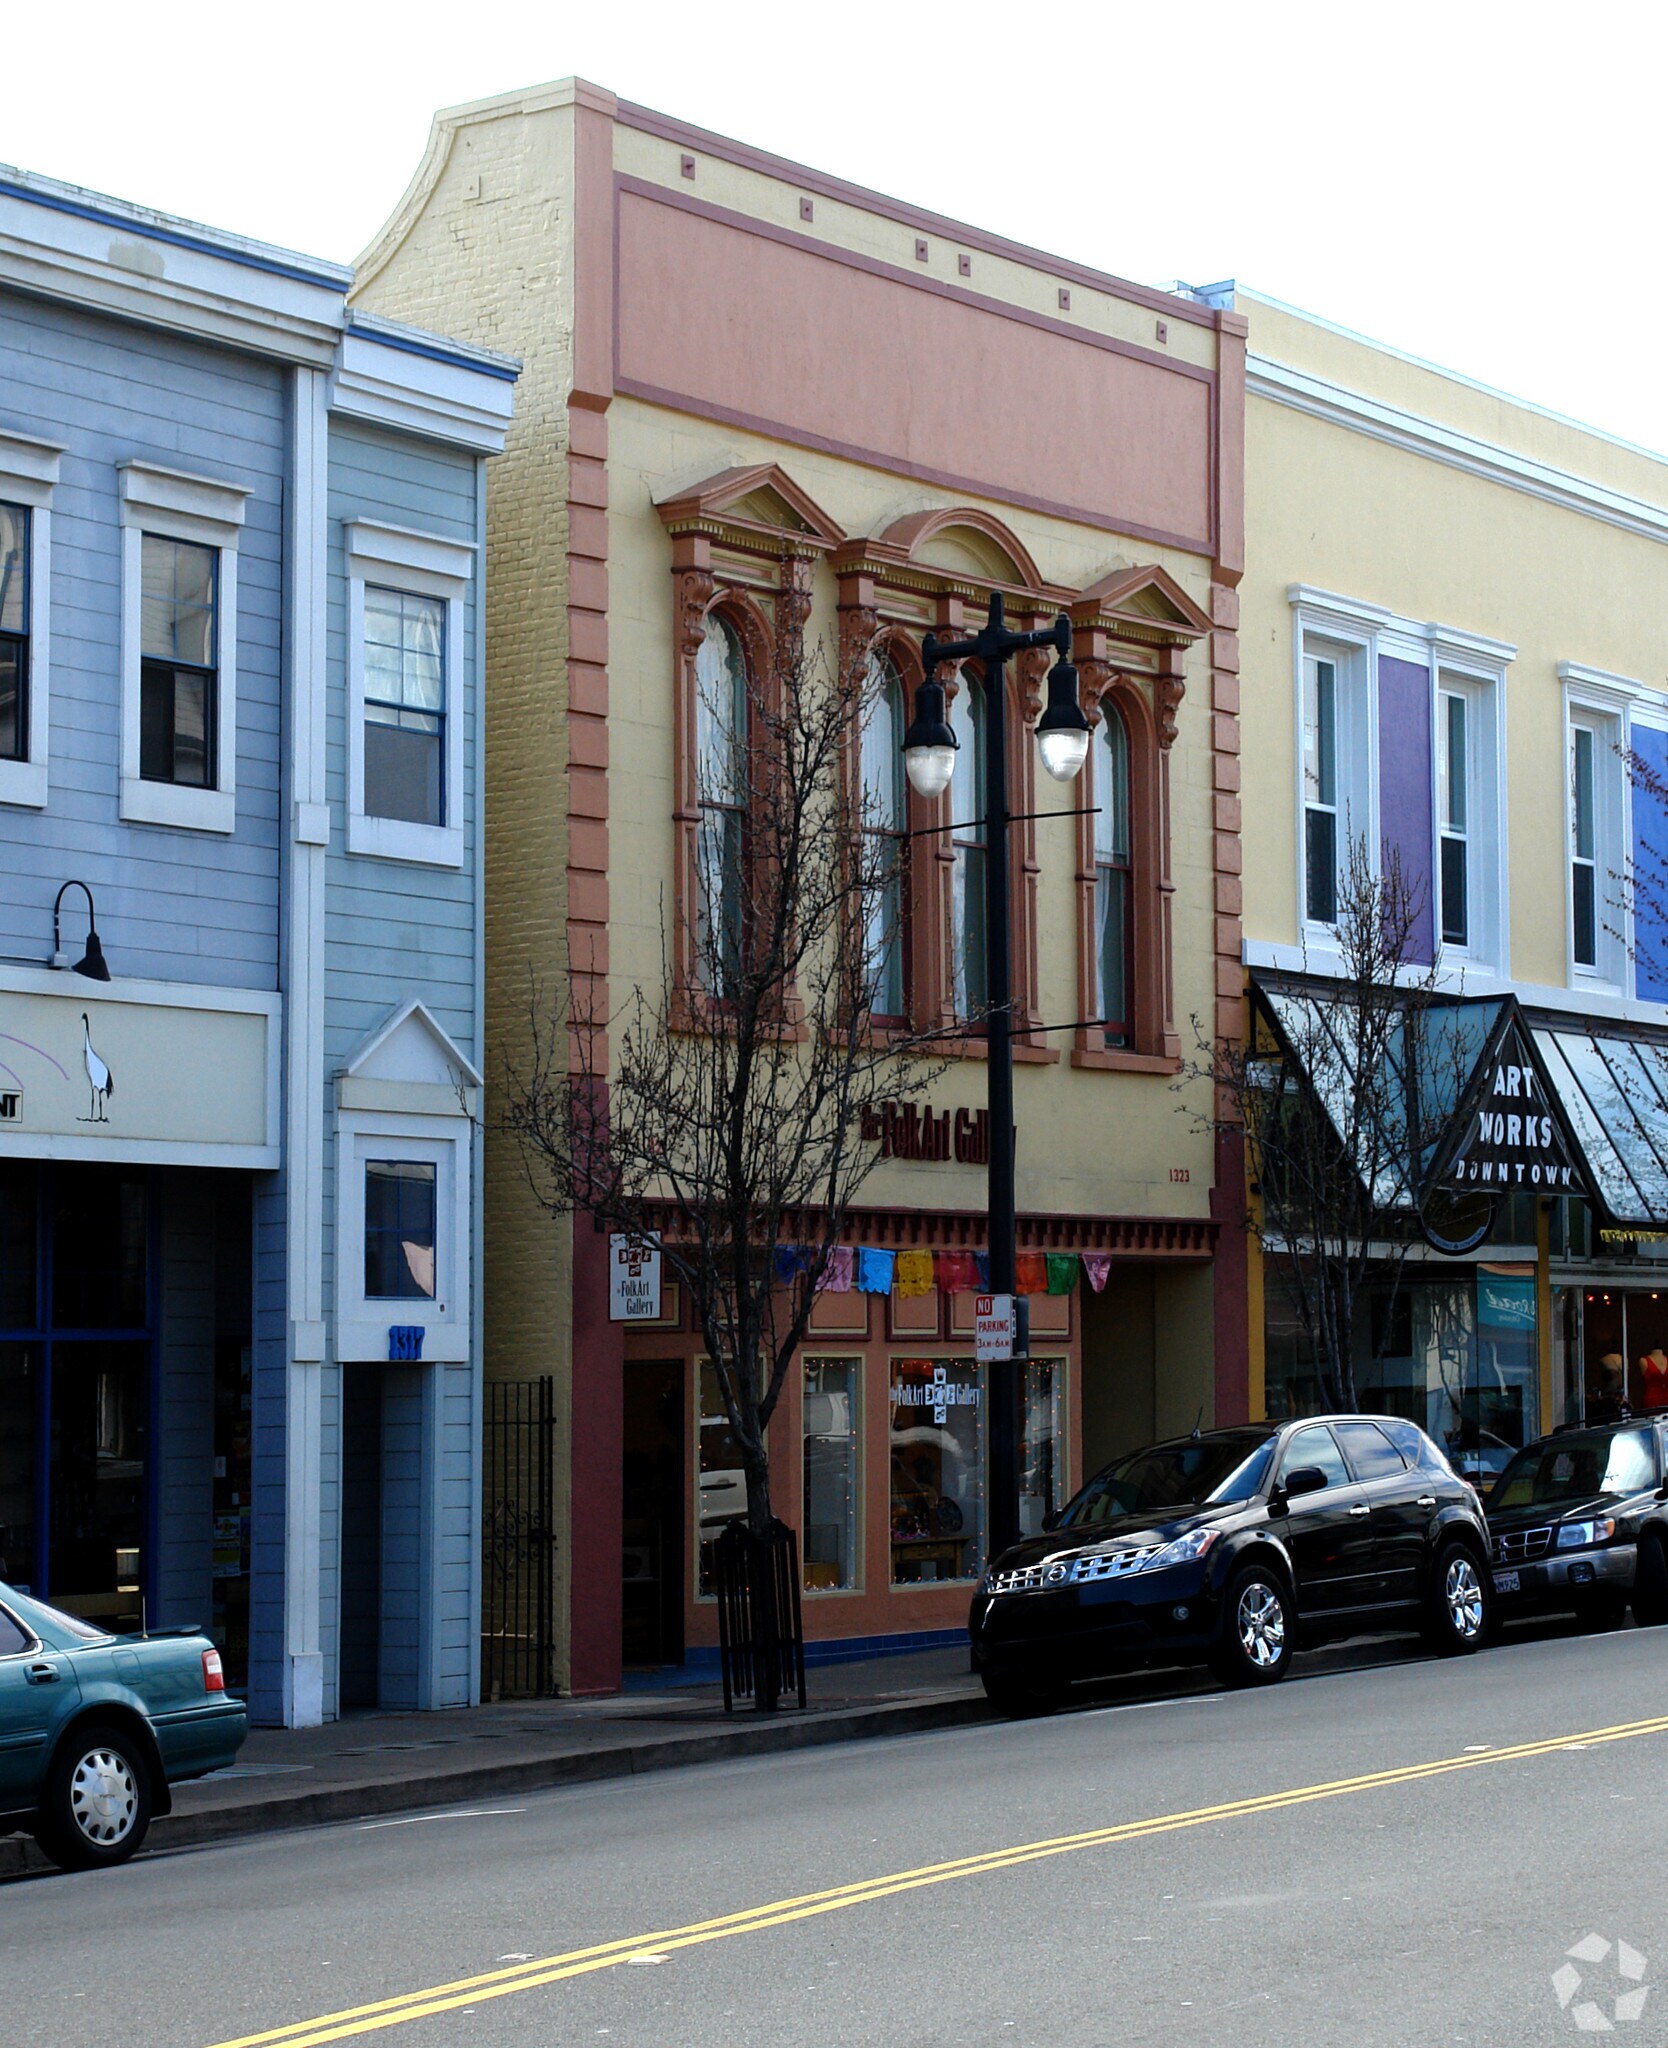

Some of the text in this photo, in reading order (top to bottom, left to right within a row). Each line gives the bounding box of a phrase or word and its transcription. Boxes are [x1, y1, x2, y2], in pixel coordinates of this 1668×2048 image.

[1493, 1065, 1533, 1098] ART
[1479, 1111, 1552, 1148] WORKS
[1169, 1168, 1190, 1182] 1323
[1456, 1160, 1571, 1185] DOWNTOWN
[627, 1299, 653, 1316] Gallery
[977, 1298, 991, 1314] NO
[978, 1319, 1009, 1333] PARKING
